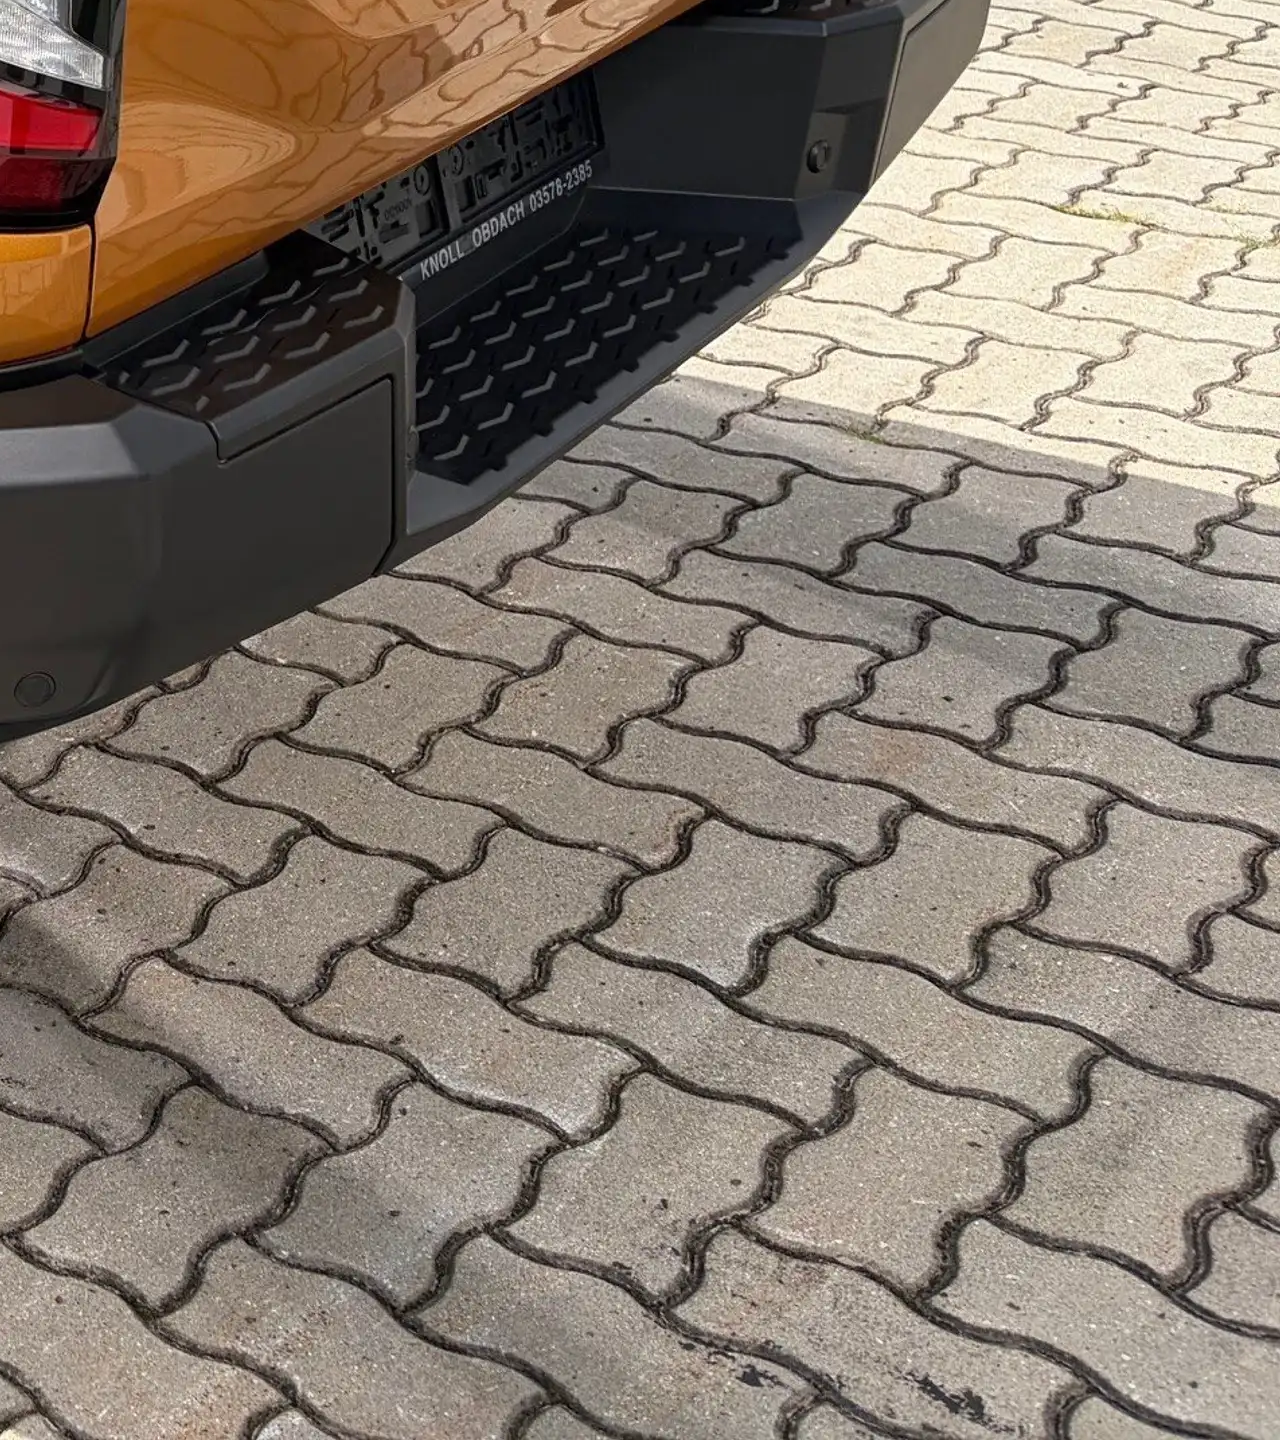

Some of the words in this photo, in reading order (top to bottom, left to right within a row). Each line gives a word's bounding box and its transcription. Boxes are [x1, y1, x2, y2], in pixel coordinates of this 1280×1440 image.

[419, 239, 465, 280] KNOLL
[471, 199, 526, 248] OBDACH
[529, 160, 593, 213] 03578-2385
